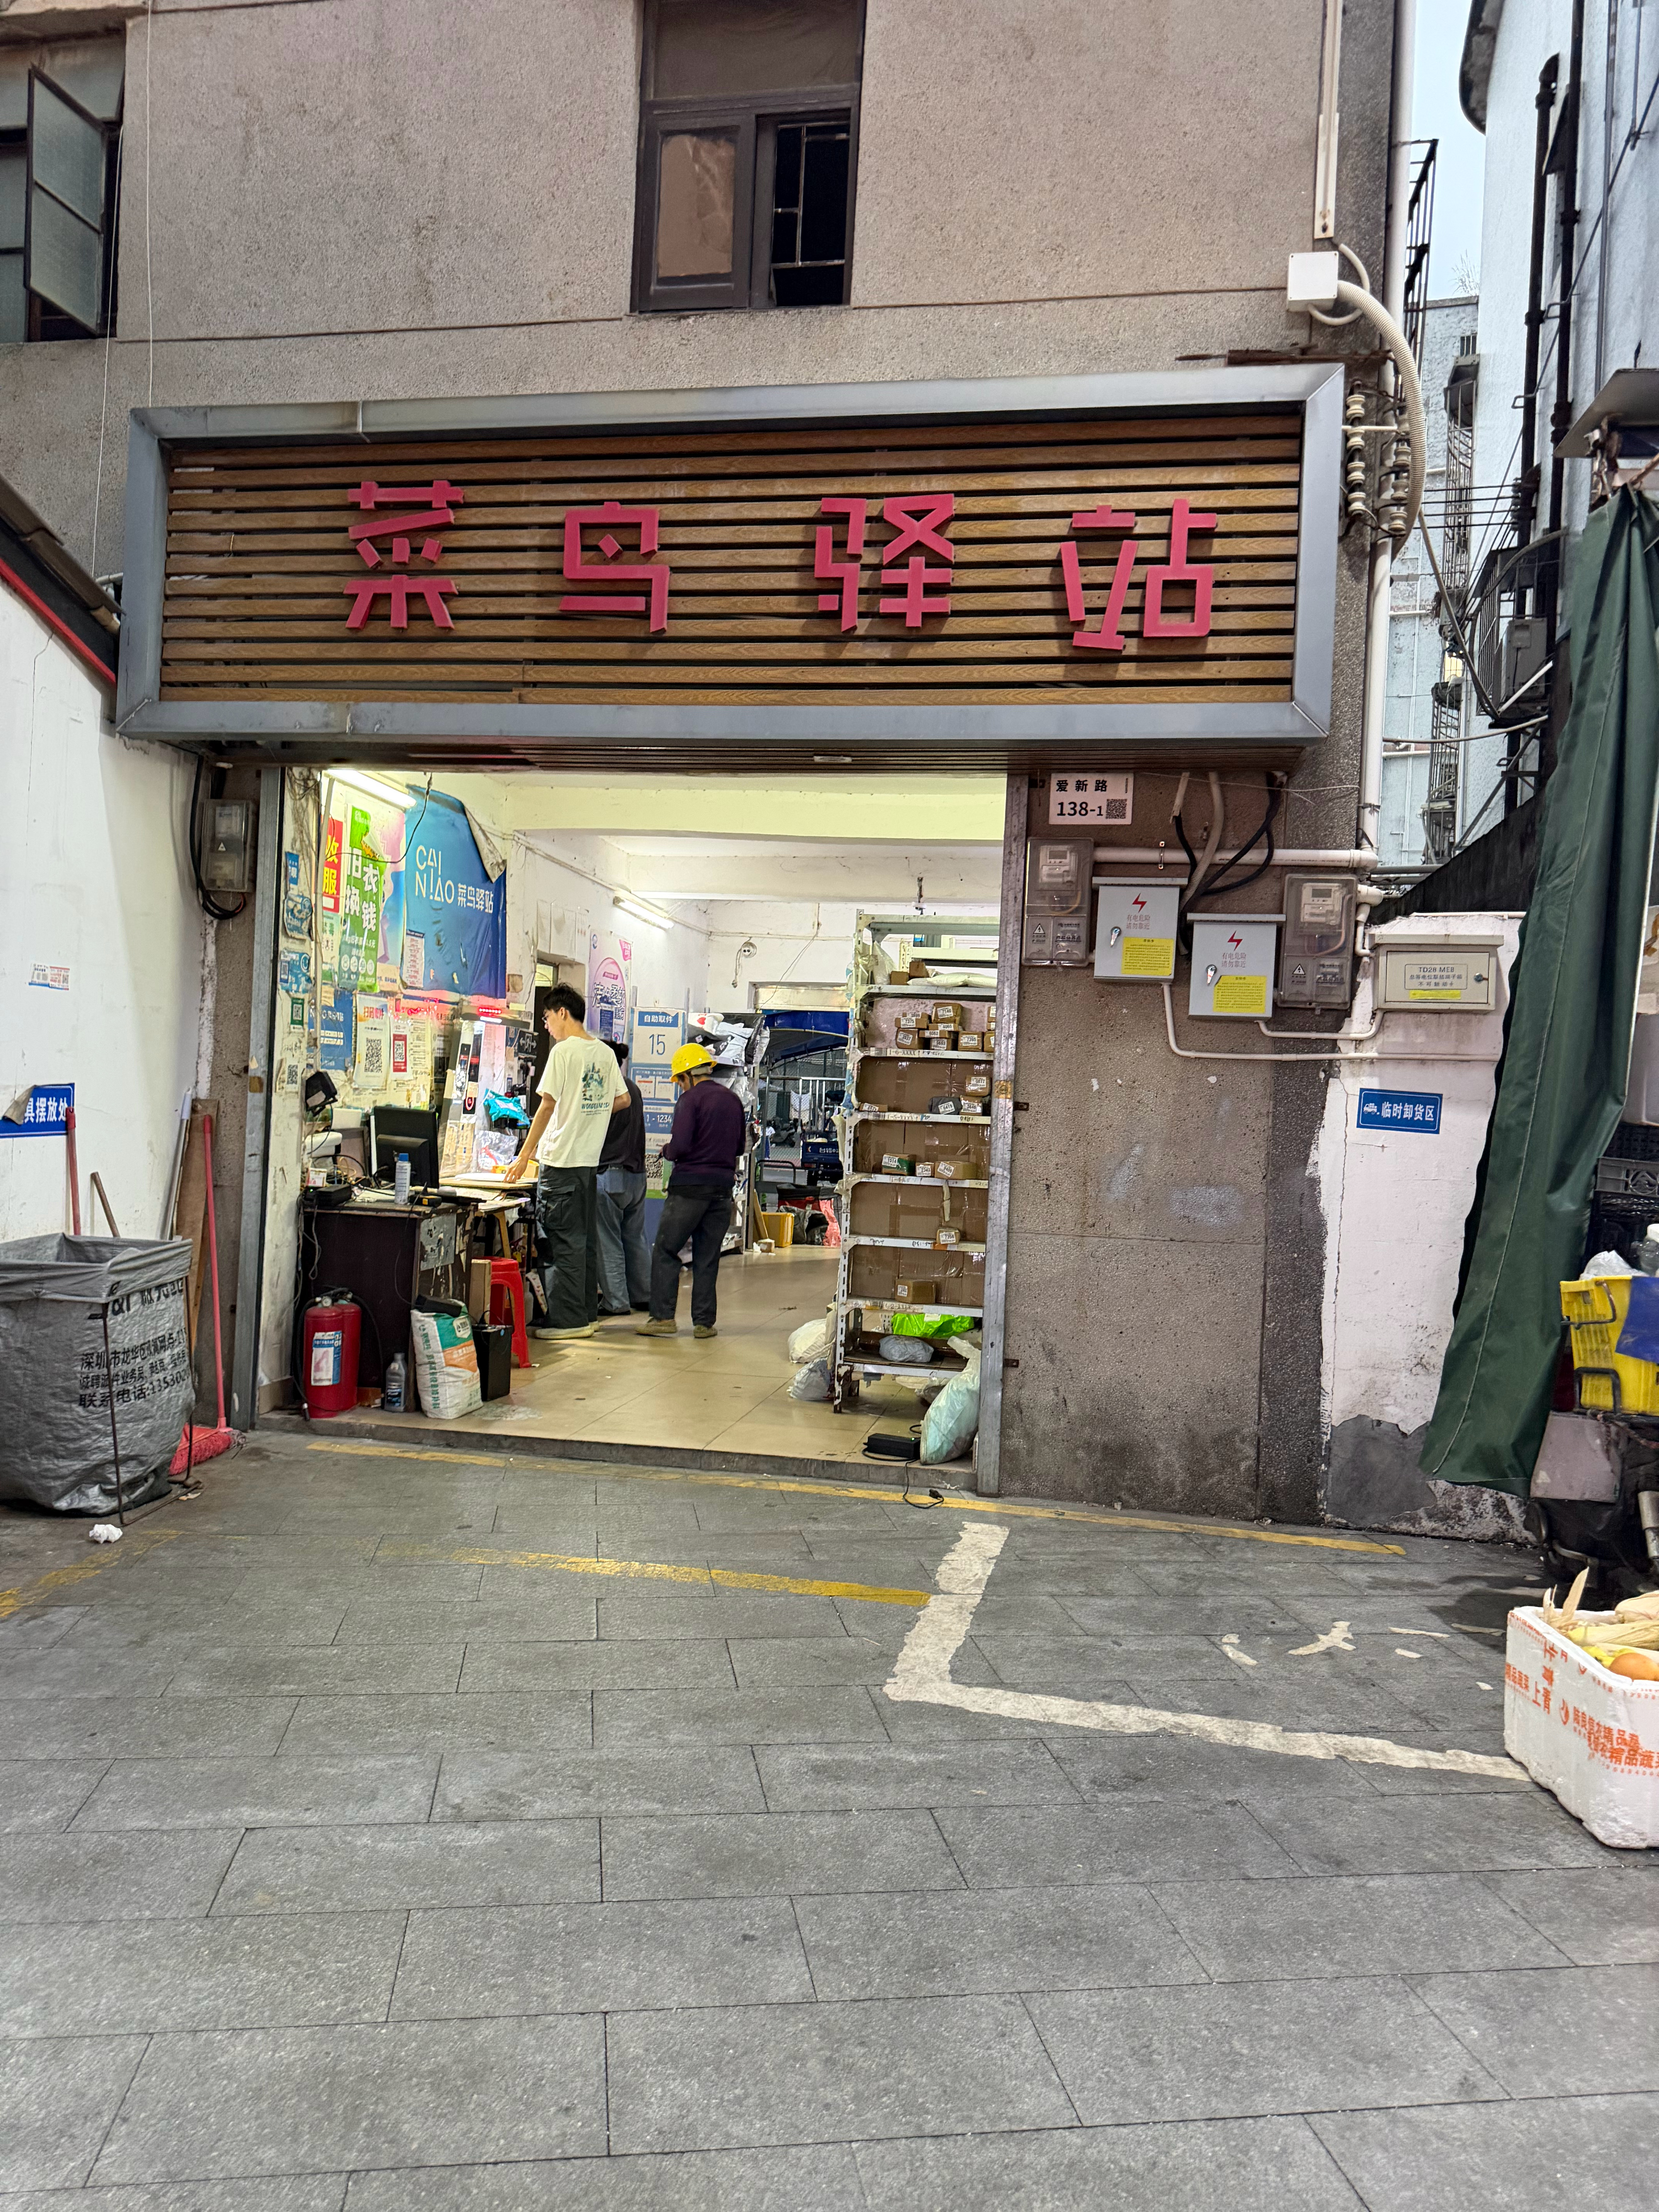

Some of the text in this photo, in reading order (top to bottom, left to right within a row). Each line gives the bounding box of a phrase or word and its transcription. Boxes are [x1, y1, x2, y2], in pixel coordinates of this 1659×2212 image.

[343, 480, 1224, 650] 菜鸟驿站
[1056, 780, 1108, 792] 爱新路
[1057, 802, 1103, 816] 138-1
[416, 845, 441, 876] CAI
[457, 882, 494, 914] 菜鸟驿站
[649, 1034, 666, 1055] 15
[658, 1115, 672, 1123] 1234
[1382, 1102, 1434, 1121] 临时卸货区
